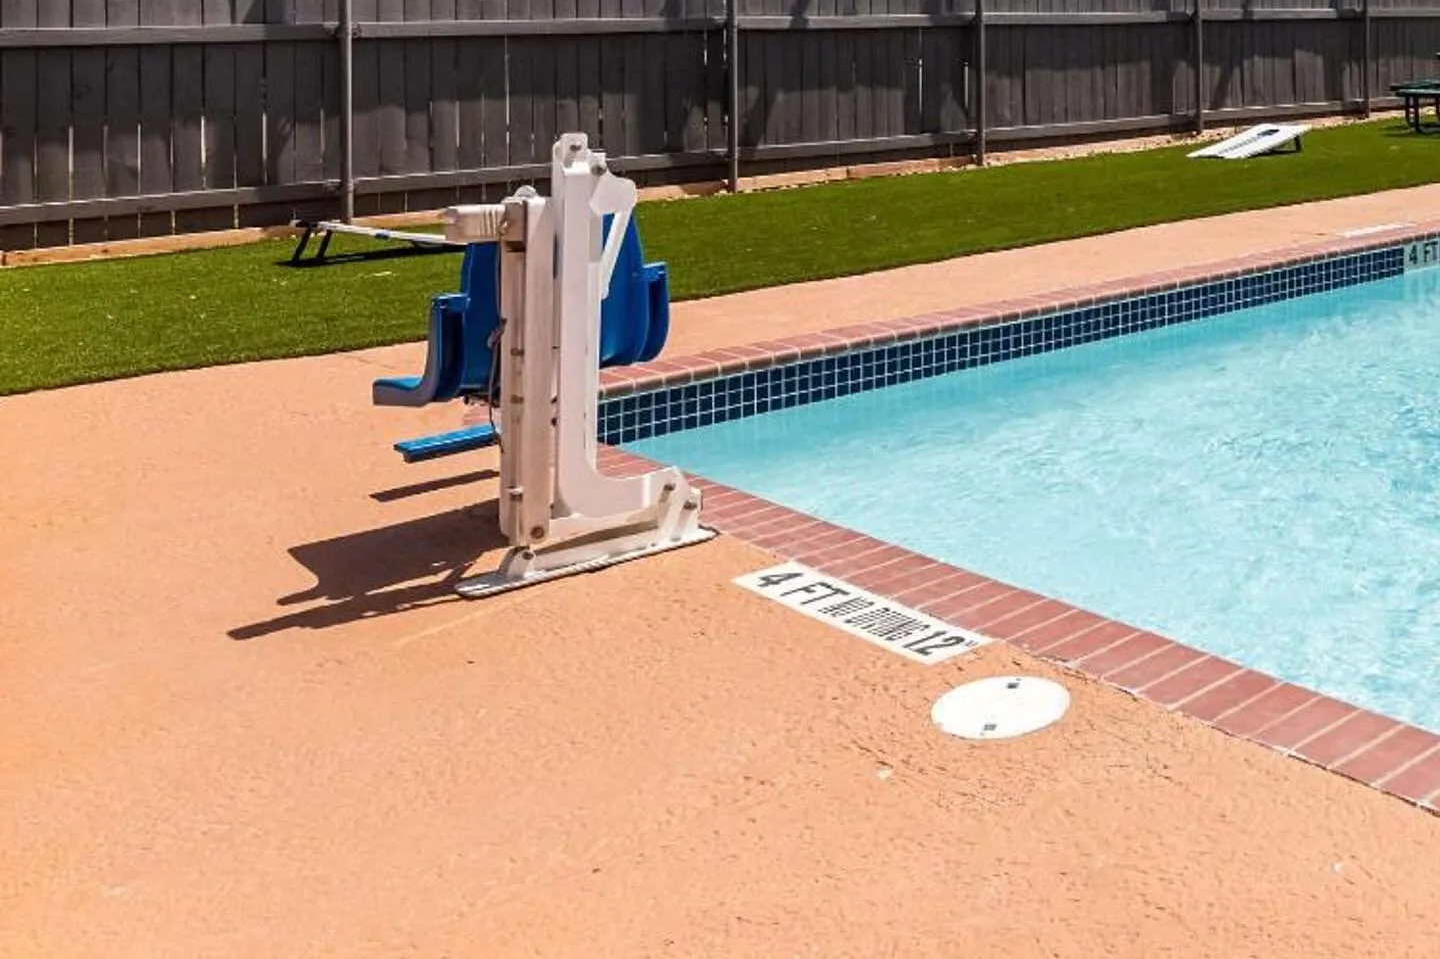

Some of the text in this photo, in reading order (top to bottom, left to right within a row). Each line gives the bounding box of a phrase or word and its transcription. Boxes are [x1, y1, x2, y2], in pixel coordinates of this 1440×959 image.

[1408, 241, 1438, 264] 4 FT
[757, 572, 803, 587] 4
[780, 582, 850, 605] FT
